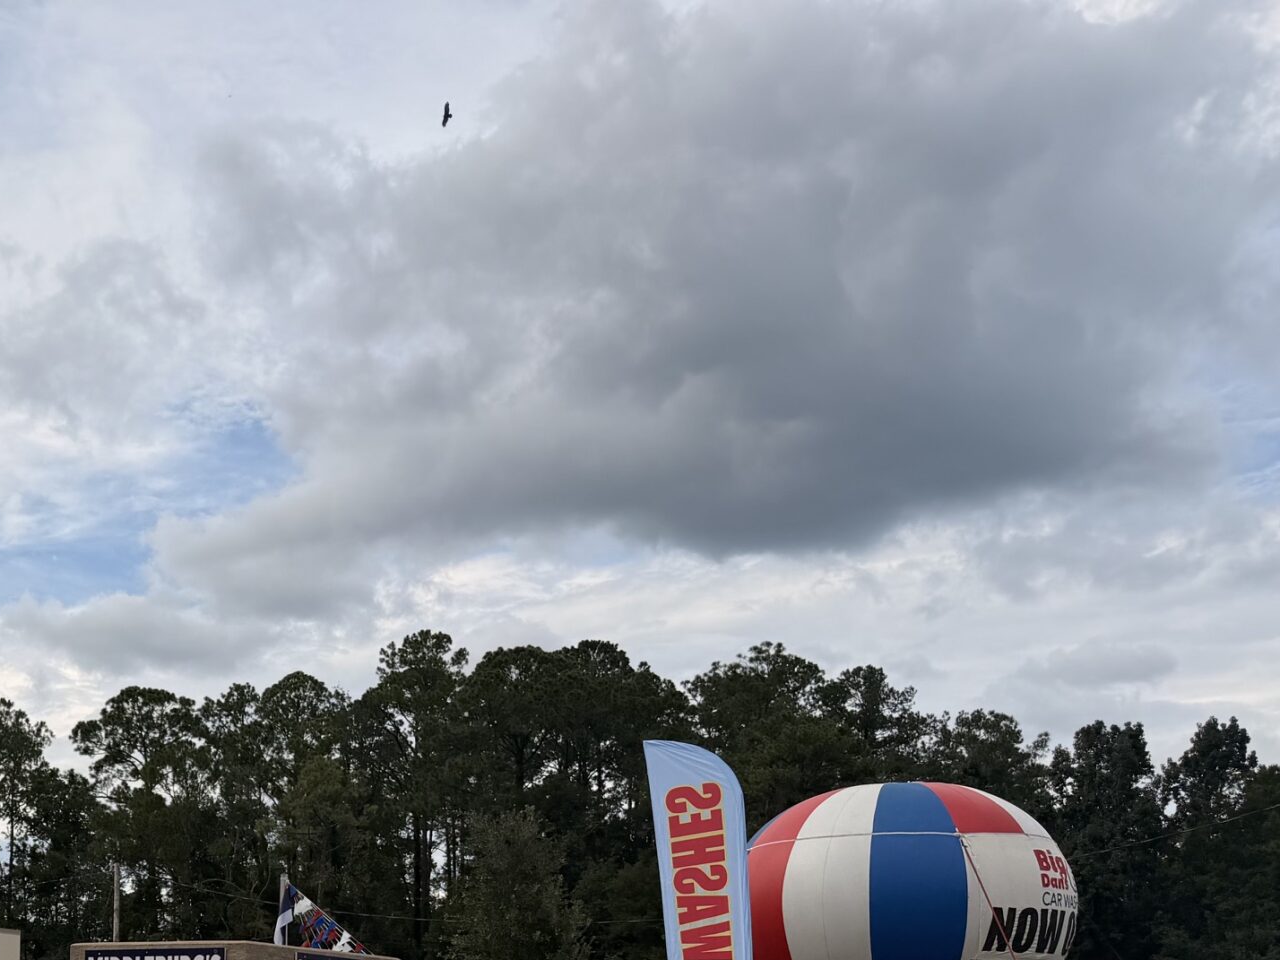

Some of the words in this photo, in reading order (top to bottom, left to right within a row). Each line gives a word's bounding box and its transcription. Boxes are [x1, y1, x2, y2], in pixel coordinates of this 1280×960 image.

[1033, 849, 1067, 879] Big
[1041, 873, 1069, 890] Dan's
[1042, 891, 1062, 907] CAR
[981, 906, 1066, 955] NOW
